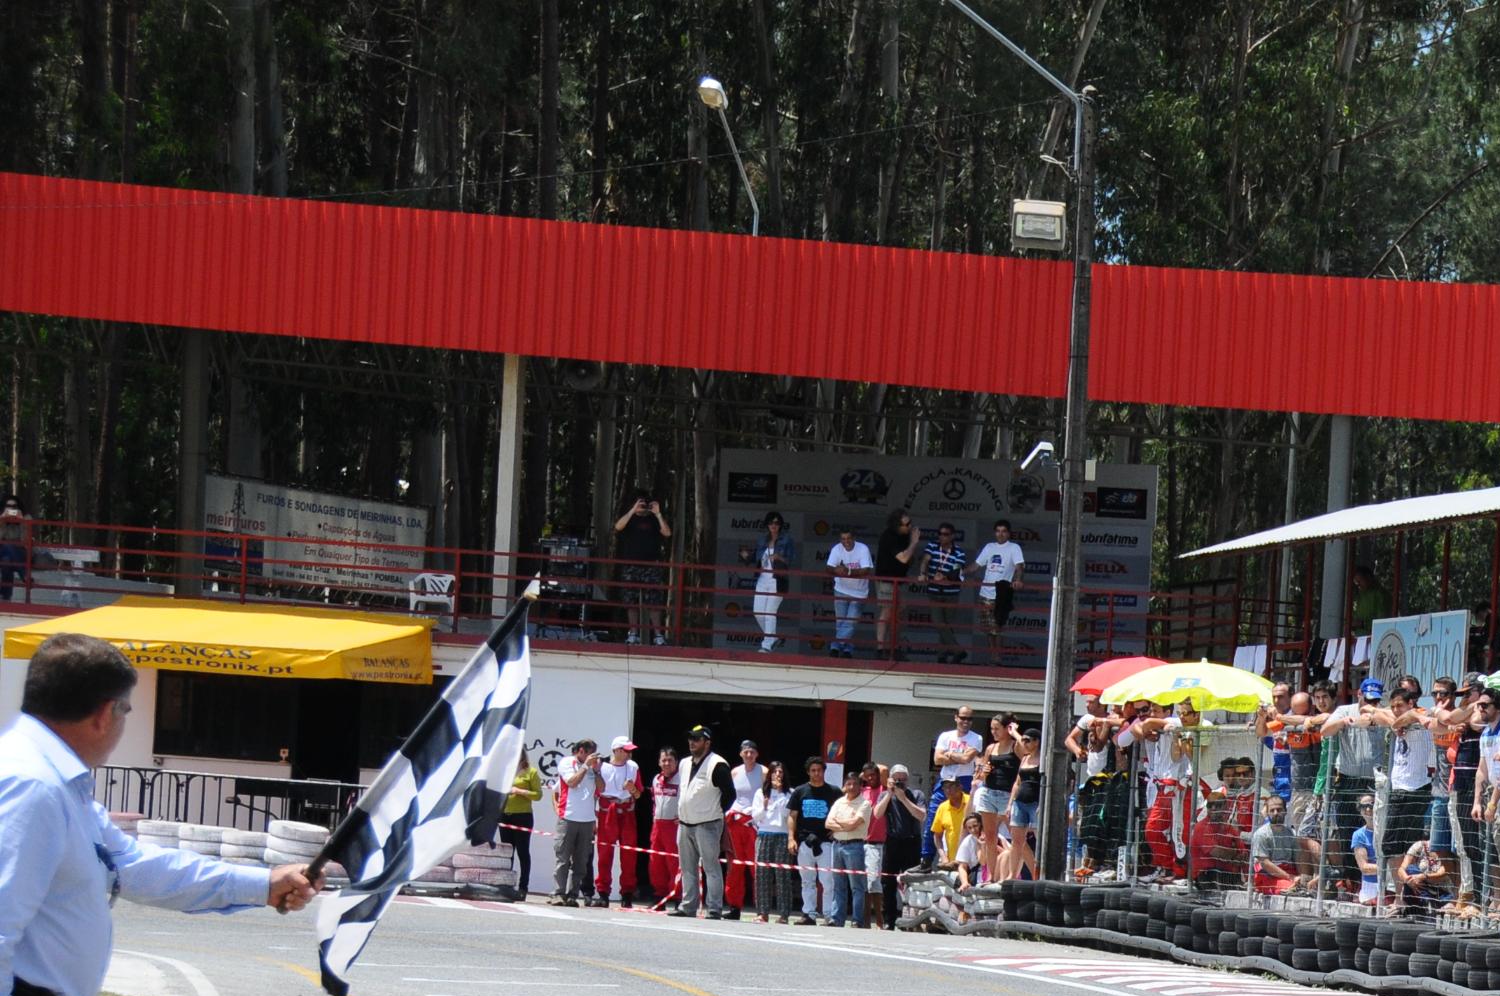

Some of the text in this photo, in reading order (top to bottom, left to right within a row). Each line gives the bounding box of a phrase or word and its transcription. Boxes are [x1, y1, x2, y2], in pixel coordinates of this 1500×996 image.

[784, 484, 830, 493] HONDA
[847, 471, 876, 489] 24
[904, 467, 1004, 511] ESCOLA KARTING
[257, 493, 286, 508] FUROS
[287, 499, 293, 508] E
[295, 501, 346, 518] SONDAGENS
[347, 508, 359, 519] DE
[928, 502, 983, 512] EUROINDY
[1081, 533, 1138, 545] ubrifatima
[375, 573, 404, 584] POMBAL
[121, 641, 252, 660] ALANÇAS
[129, 654, 294, 675] .pestronix.pt
